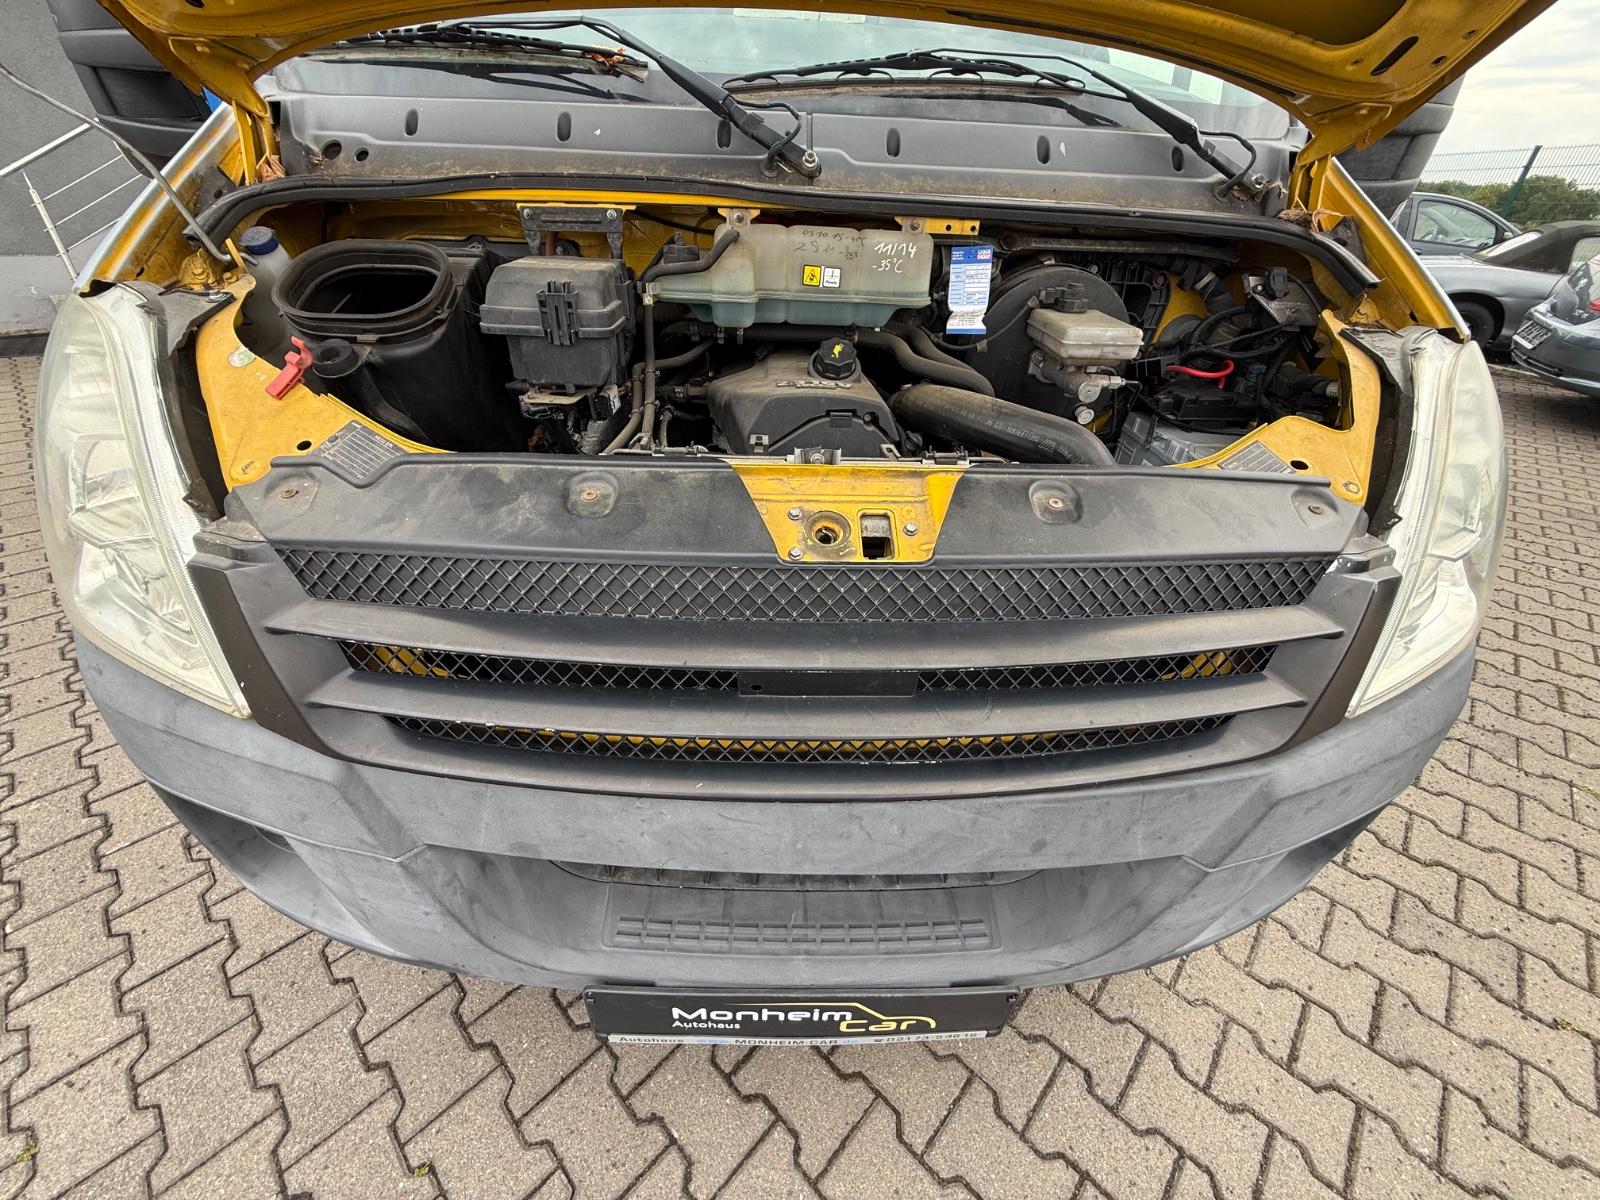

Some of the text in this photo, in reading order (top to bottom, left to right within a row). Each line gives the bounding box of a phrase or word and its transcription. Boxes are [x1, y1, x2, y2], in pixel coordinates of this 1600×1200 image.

[874, 242, 918, 258] 11/14
[871, 257, 903, 274] -35°C
[671, 1006, 852, 1022] Monheim
[672, 1021, 740, 1029] Autohaus
[839, 1019, 917, 1032] Car
